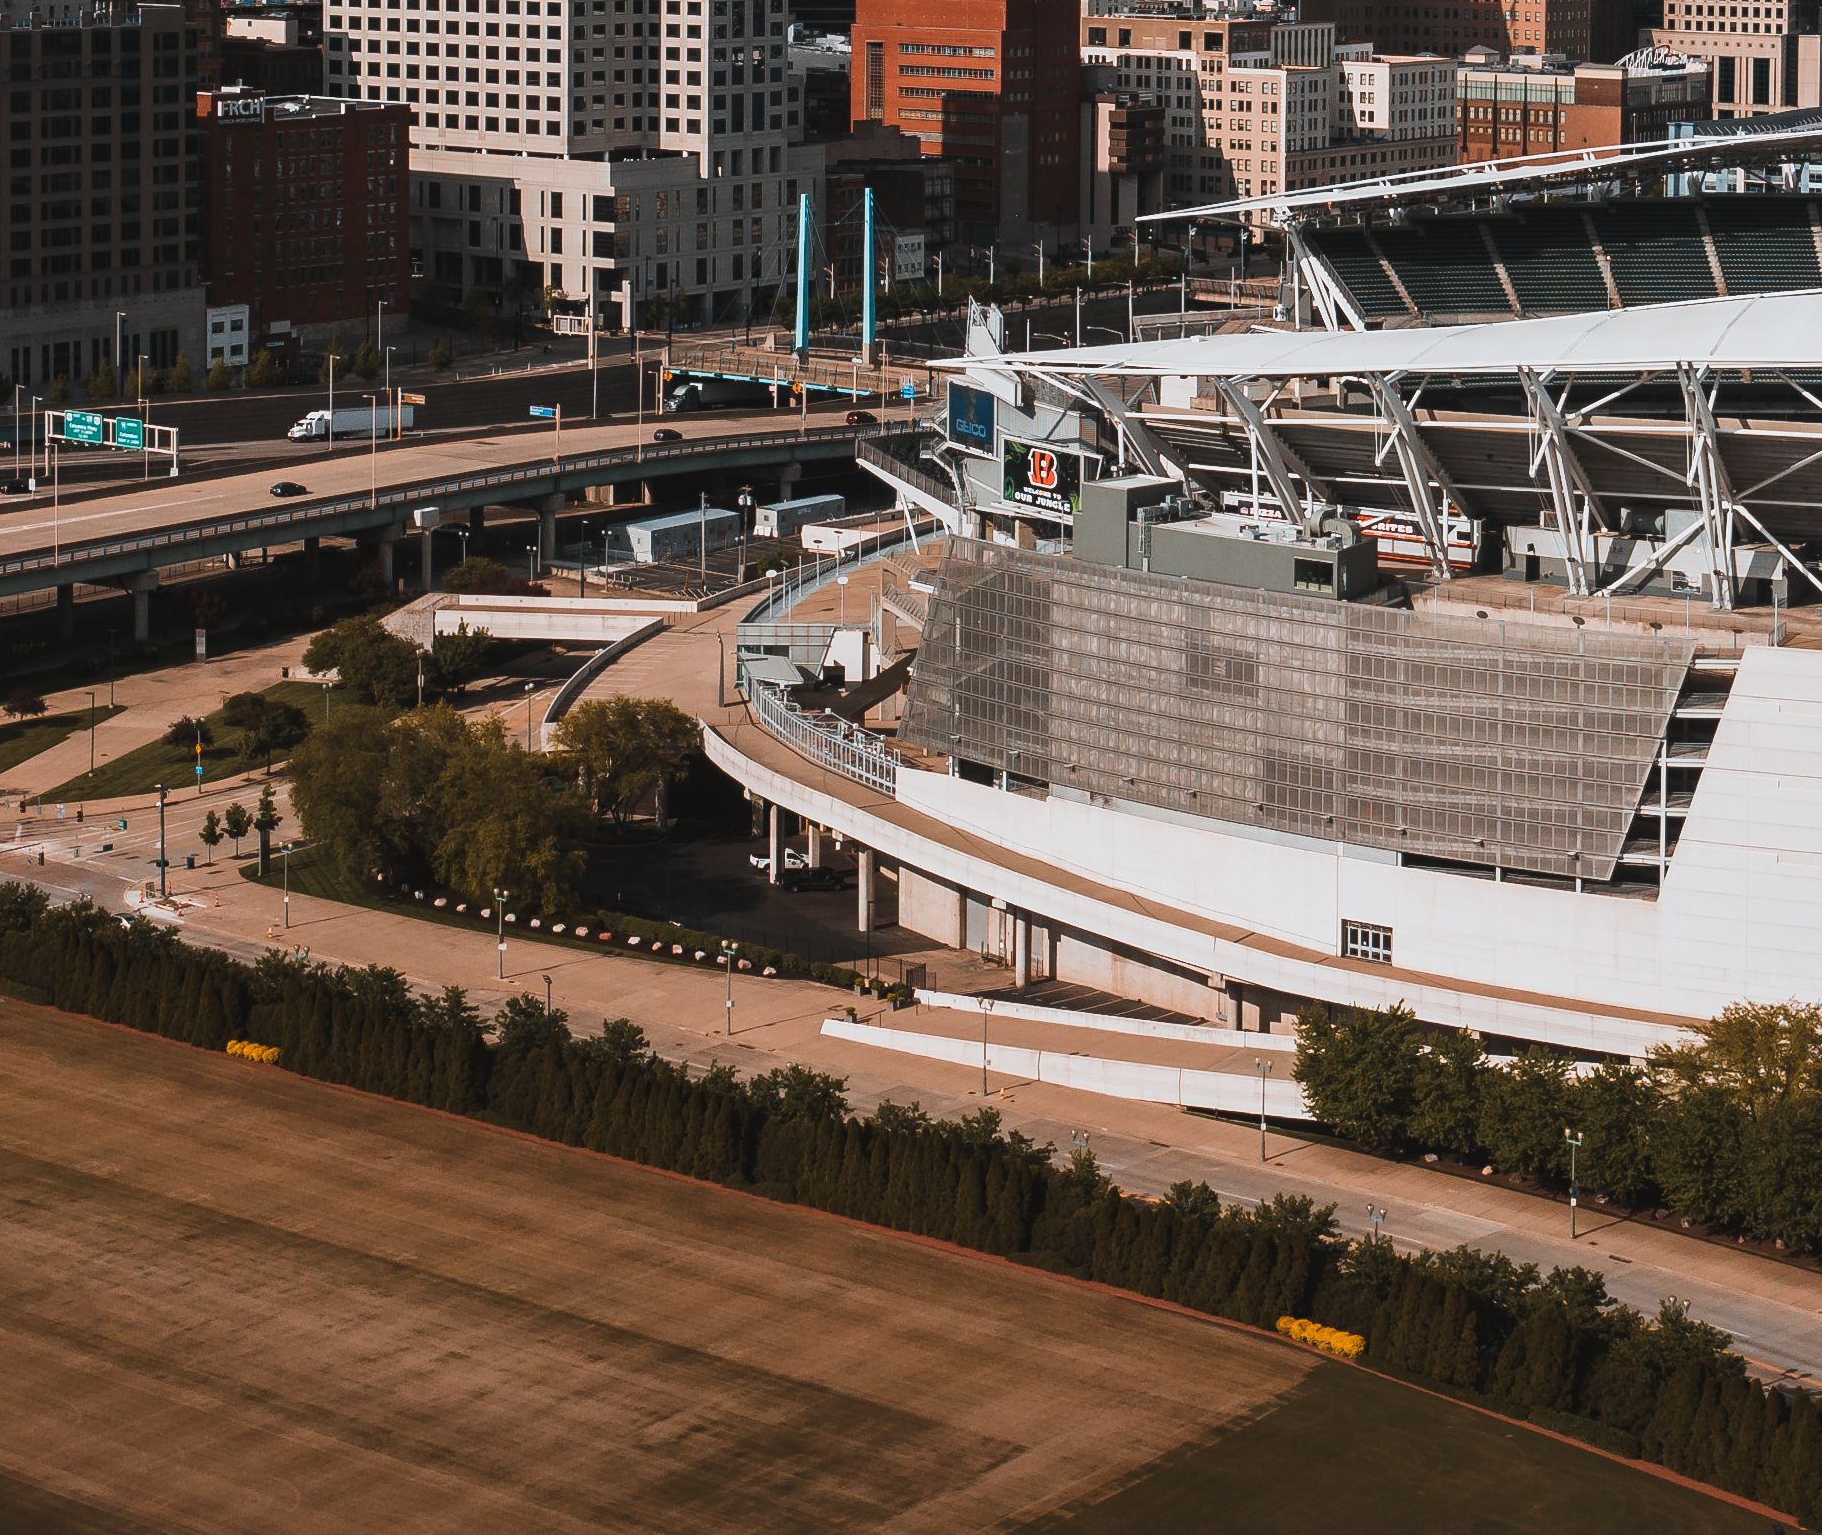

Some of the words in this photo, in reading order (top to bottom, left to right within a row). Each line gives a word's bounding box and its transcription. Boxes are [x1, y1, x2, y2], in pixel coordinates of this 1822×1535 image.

[221, 100, 261, 116] FRCH
[956, 419, 986, 438] GEICO
[1015, 491, 1033, 503] OUR
[1036, 496, 1071, 512] JUNGLE
[1053, 492, 1062, 500] TO
